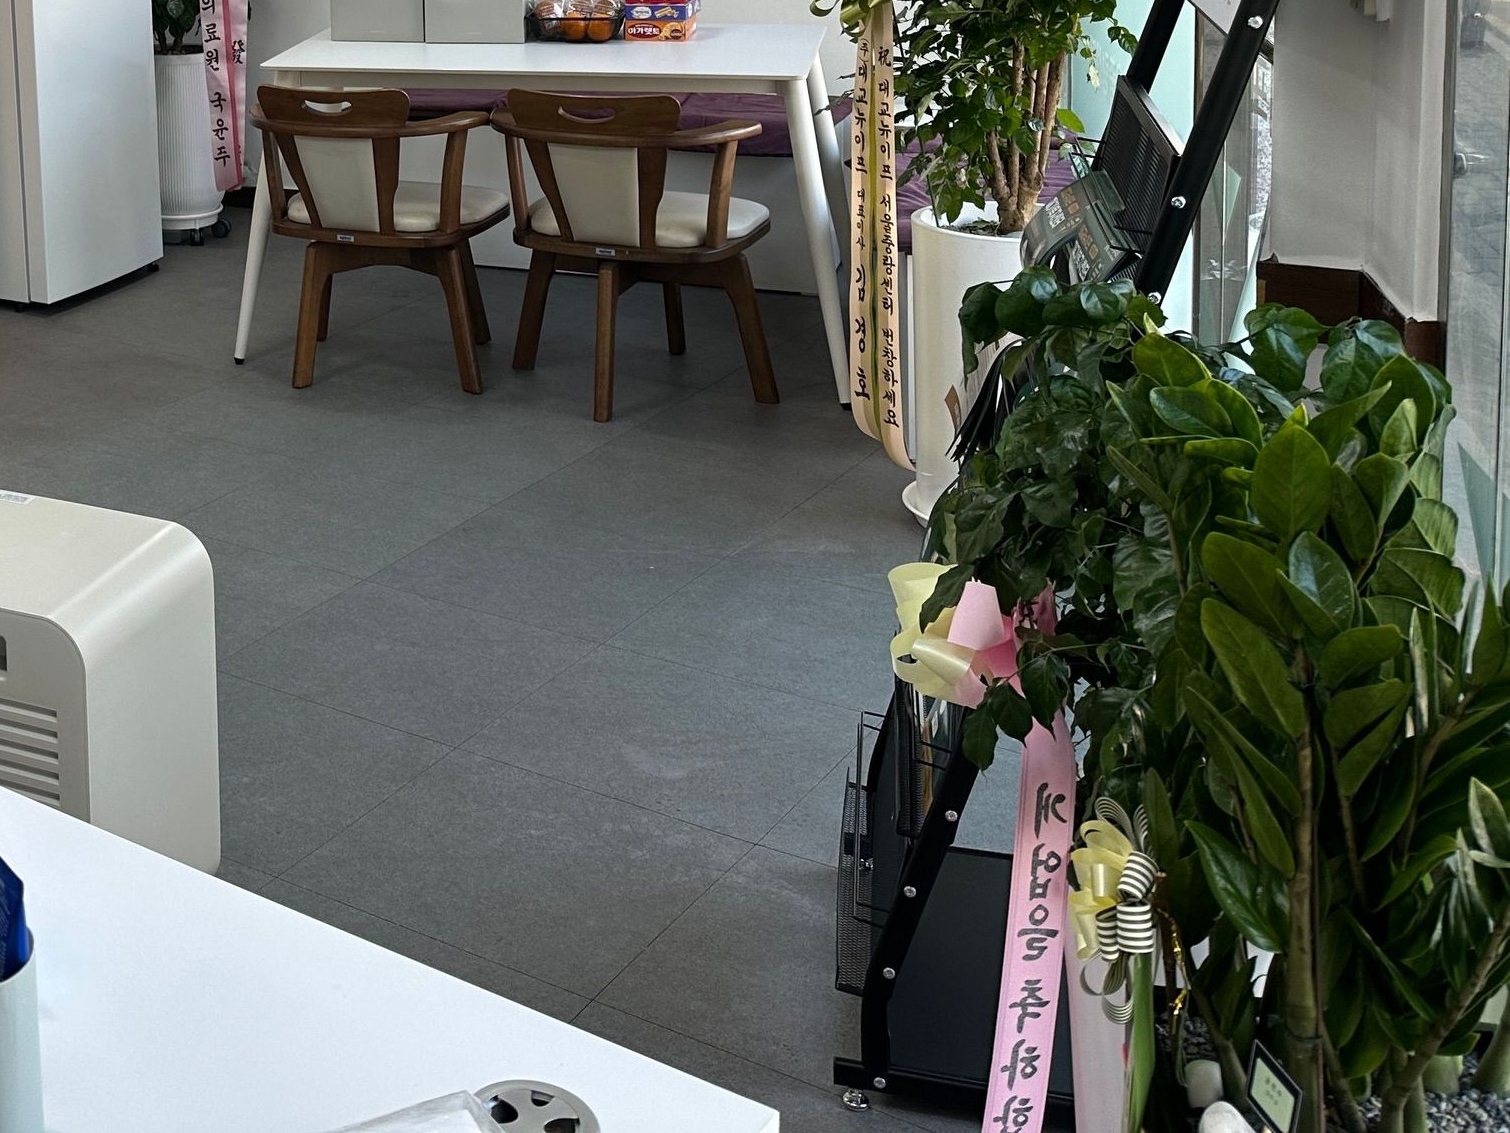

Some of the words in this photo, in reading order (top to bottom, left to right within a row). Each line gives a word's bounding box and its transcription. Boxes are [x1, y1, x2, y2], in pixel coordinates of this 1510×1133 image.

[854, 38, 870, 175] (주)대교뉴이프
[878, 46, 892, 67] 祝
[878, 79, 893, 181] 대교뉴이프
[856, 187, 866, 250] 대표이사
[854, 264, 870, 401] 김경호
[881, 327, 899, 428] 번창하세요
